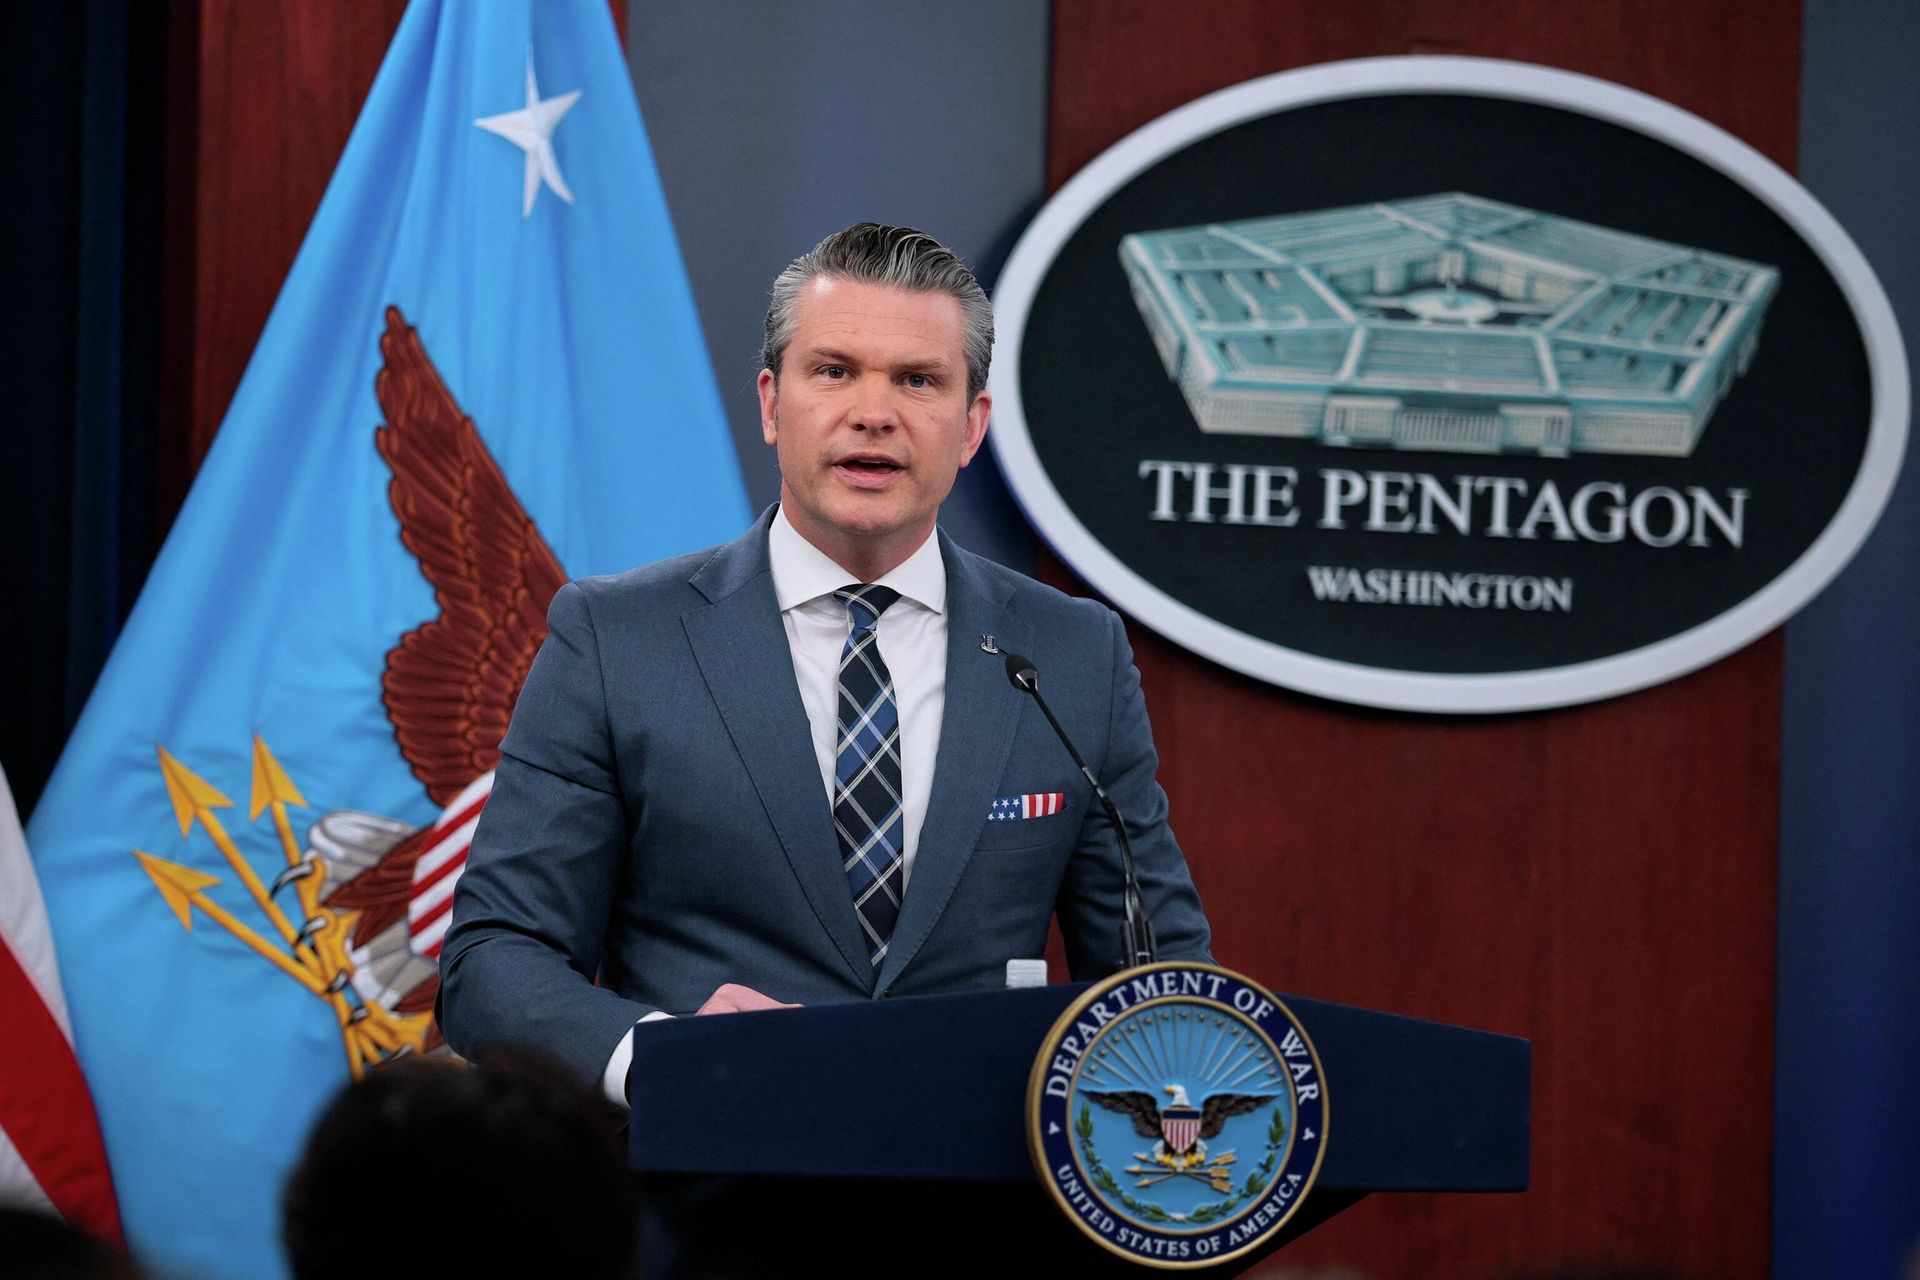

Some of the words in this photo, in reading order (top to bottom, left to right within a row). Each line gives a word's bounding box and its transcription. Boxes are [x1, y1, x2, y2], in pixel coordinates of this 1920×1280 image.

[1138, 460, 1299, 528] THE
[1318, 468, 1750, 549] PENTAGON
[1306, 565, 1573, 612] WASHINGTON
[1046, 971, 1227, 1099] DEPARTMENT
[1234, 987, 1274, 1022] OF
[1279, 1027, 1319, 1105] WAR
[1057, 1164, 1114, 1234] UNITED
[1116, 1226, 1190, 1257] STATES
[1195, 1237, 1222, 1256] OF
[1228, 1172, 1302, 1247] AMERICA
